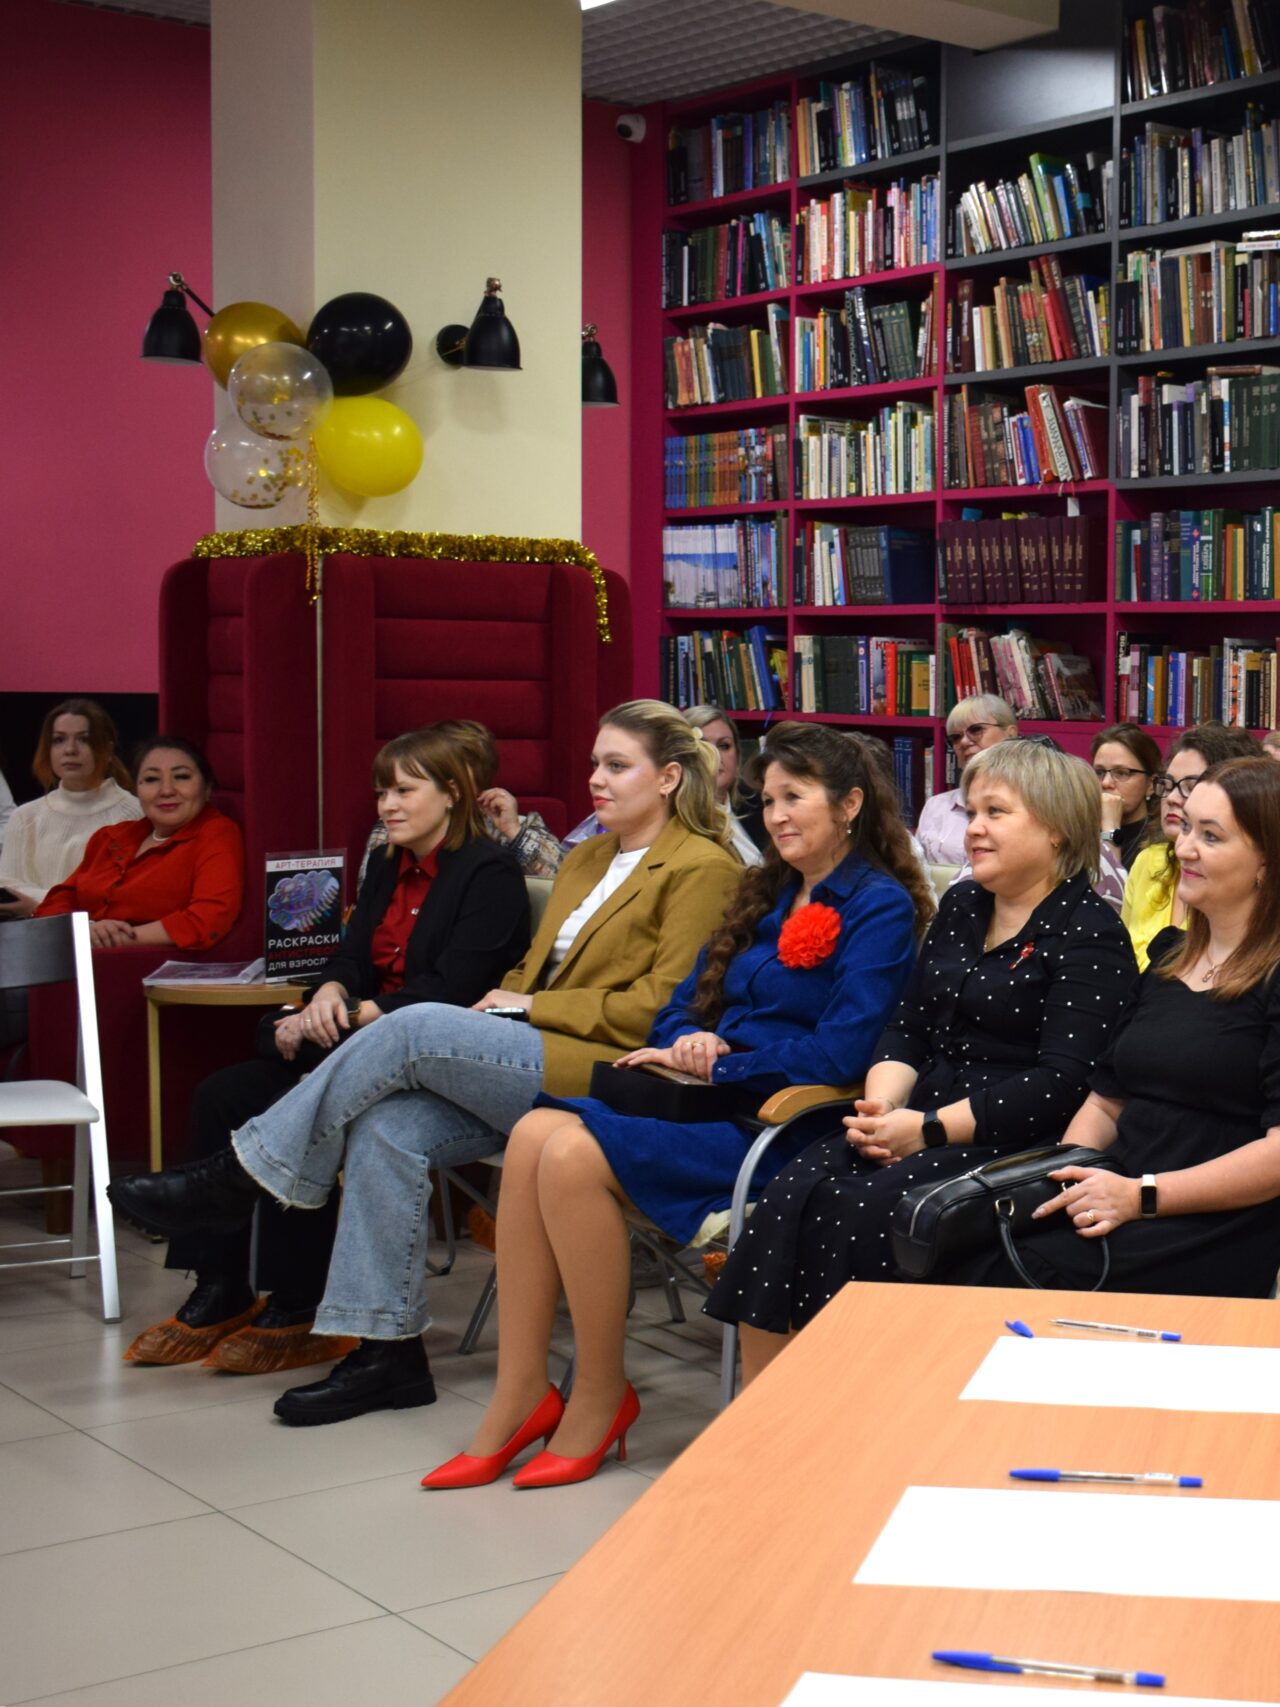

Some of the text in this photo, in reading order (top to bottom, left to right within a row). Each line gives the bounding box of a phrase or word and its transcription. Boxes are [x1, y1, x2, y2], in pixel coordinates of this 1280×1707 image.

[275, 858, 336, 870] АРТ-ТЕРАПИЯ
[268, 934, 340, 949] РАСКРАСКИ
[268, 957, 328, 971] ДЛЯ ВЗРОСЛ
